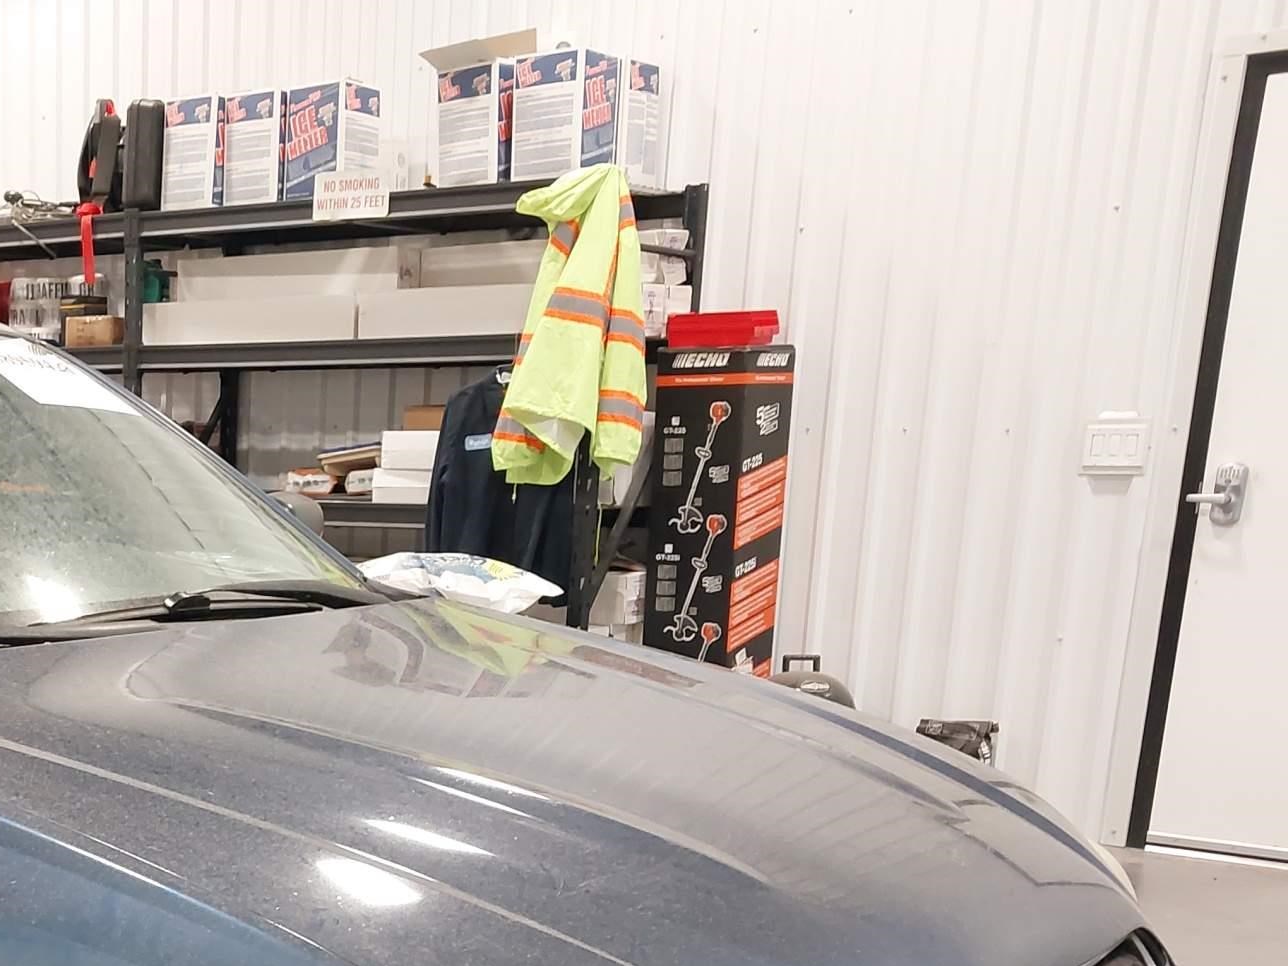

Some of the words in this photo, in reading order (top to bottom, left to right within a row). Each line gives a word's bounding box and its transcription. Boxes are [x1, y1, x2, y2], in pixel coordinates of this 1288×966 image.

[289, 104, 318, 141] ICE
[323, 180, 336, 193] NO
[339, 177, 380, 192] SMOKING
[316, 197, 349, 211] WITHIN
[350, 196, 362, 209] 25
[363, 194, 386, 208] FEET
[682, 352, 731, 368] ECHO
[761, 352, 791, 367] ECHO
